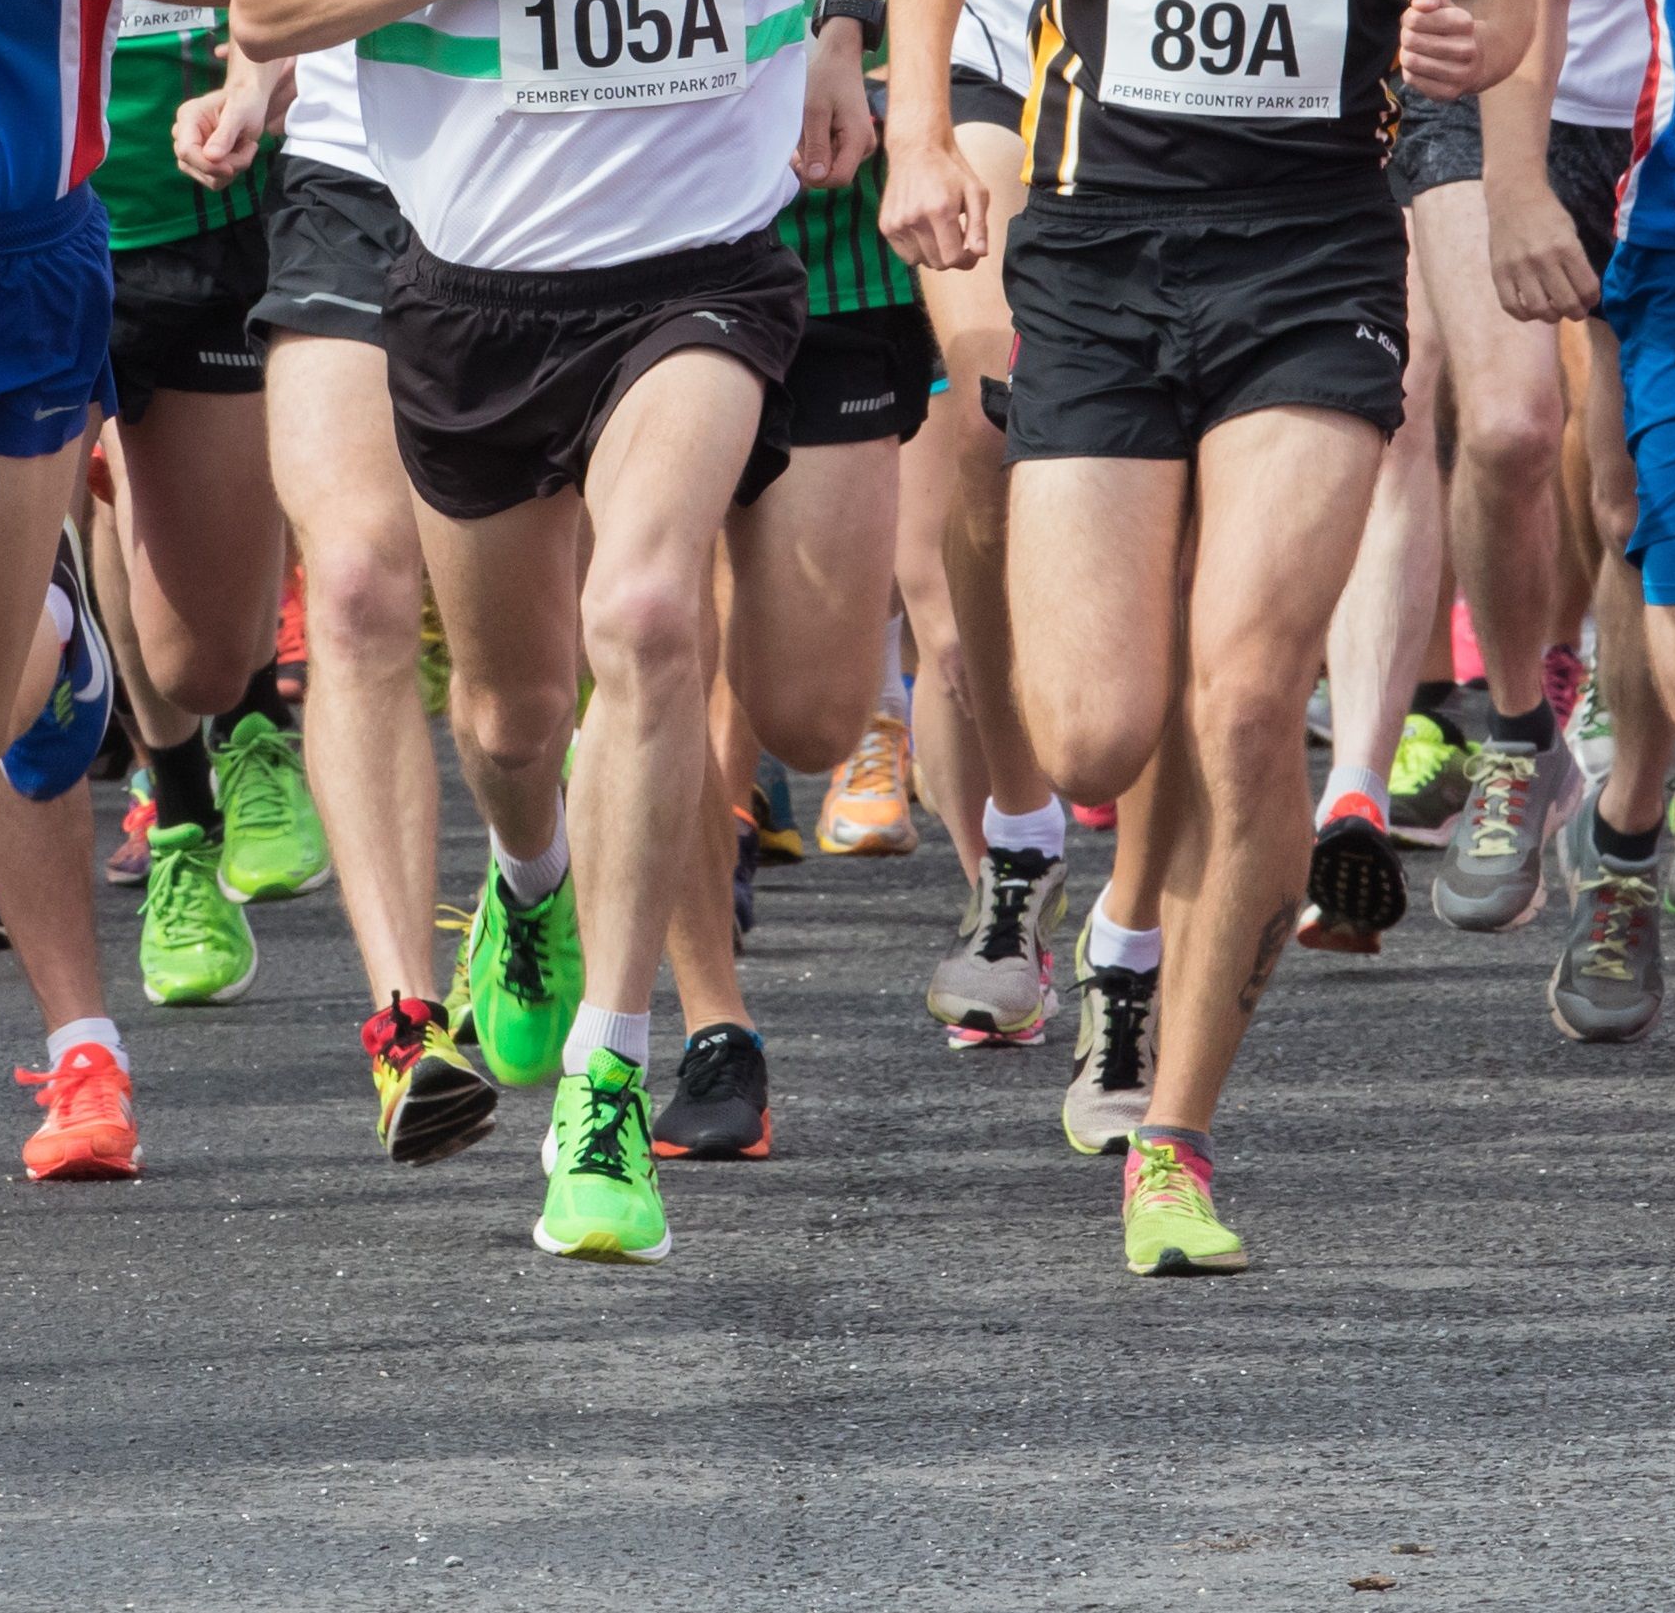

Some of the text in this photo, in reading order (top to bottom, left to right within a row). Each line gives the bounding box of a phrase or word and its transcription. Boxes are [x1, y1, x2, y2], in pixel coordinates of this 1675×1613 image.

[134, 12, 168, 27] PARK
[174, 7, 203, 22] 2017
[516, 72, 737, 104] PEMBREY COUNTRY PARK 2017
[1112, 84, 1329, 109] PEMBREY COUNTRY PARK 2017
